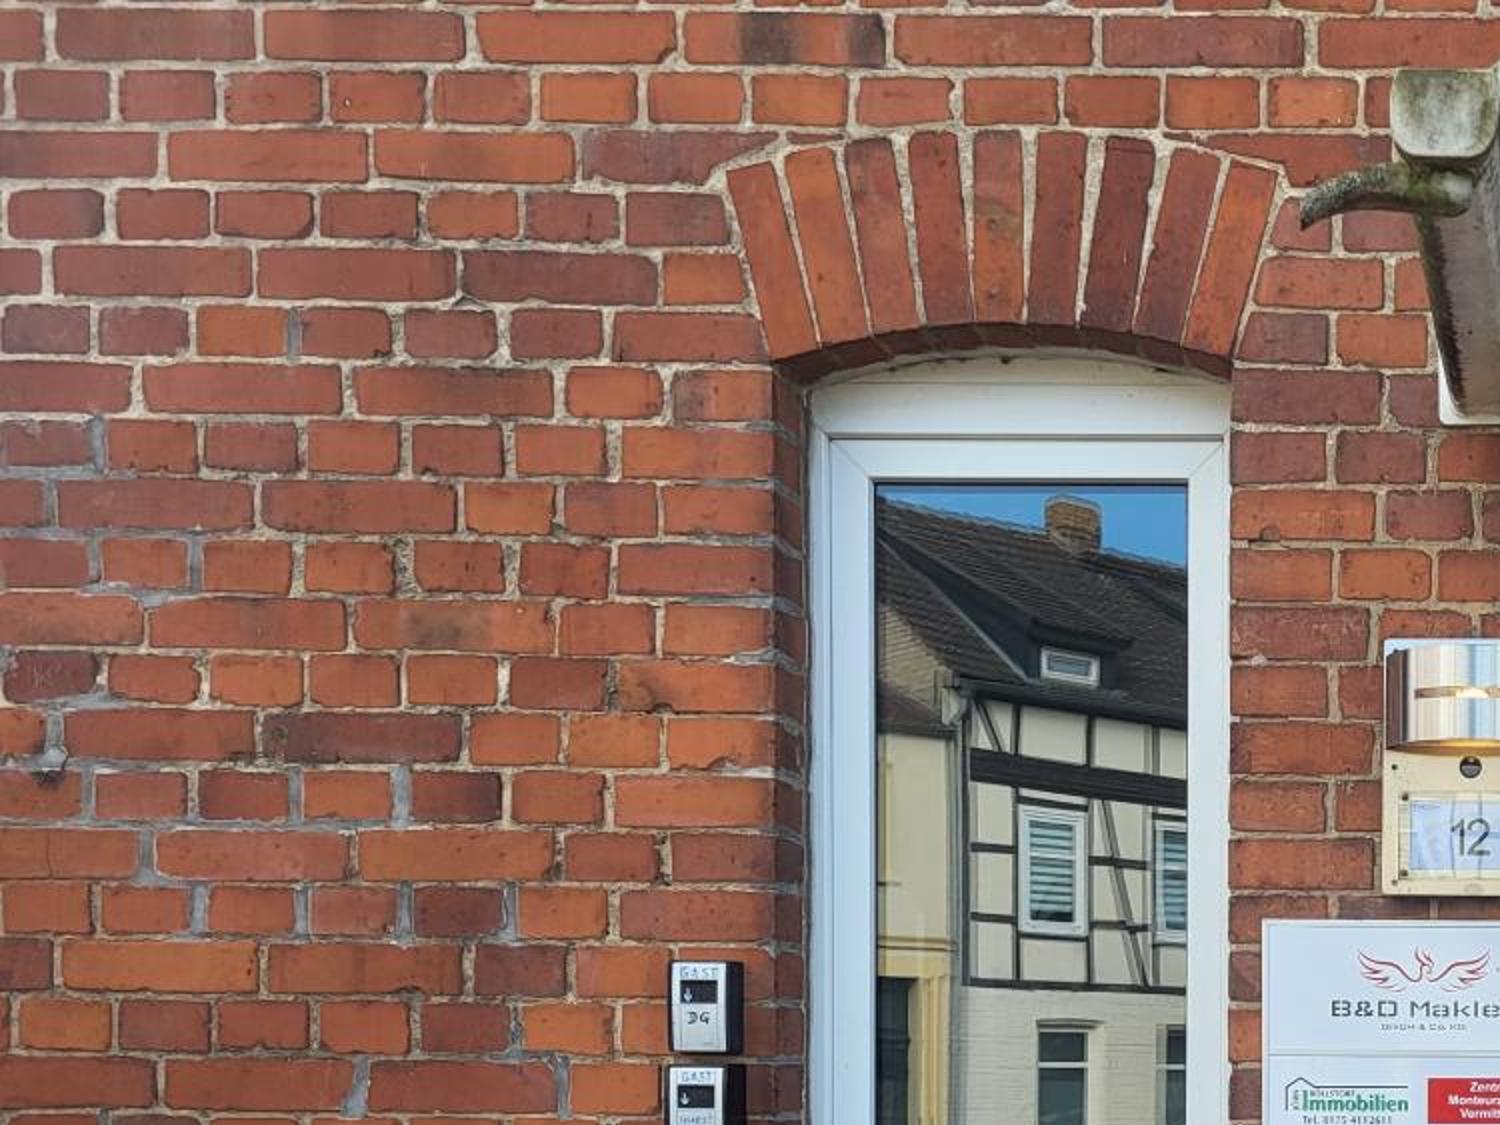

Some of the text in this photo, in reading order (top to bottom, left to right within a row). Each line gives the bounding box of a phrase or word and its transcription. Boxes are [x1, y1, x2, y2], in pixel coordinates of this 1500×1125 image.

[1450, 818, 1491, 857] 12
[680, 966, 719, 978] GAST
[1303, 1090, 1408, 1112] Immobilien
